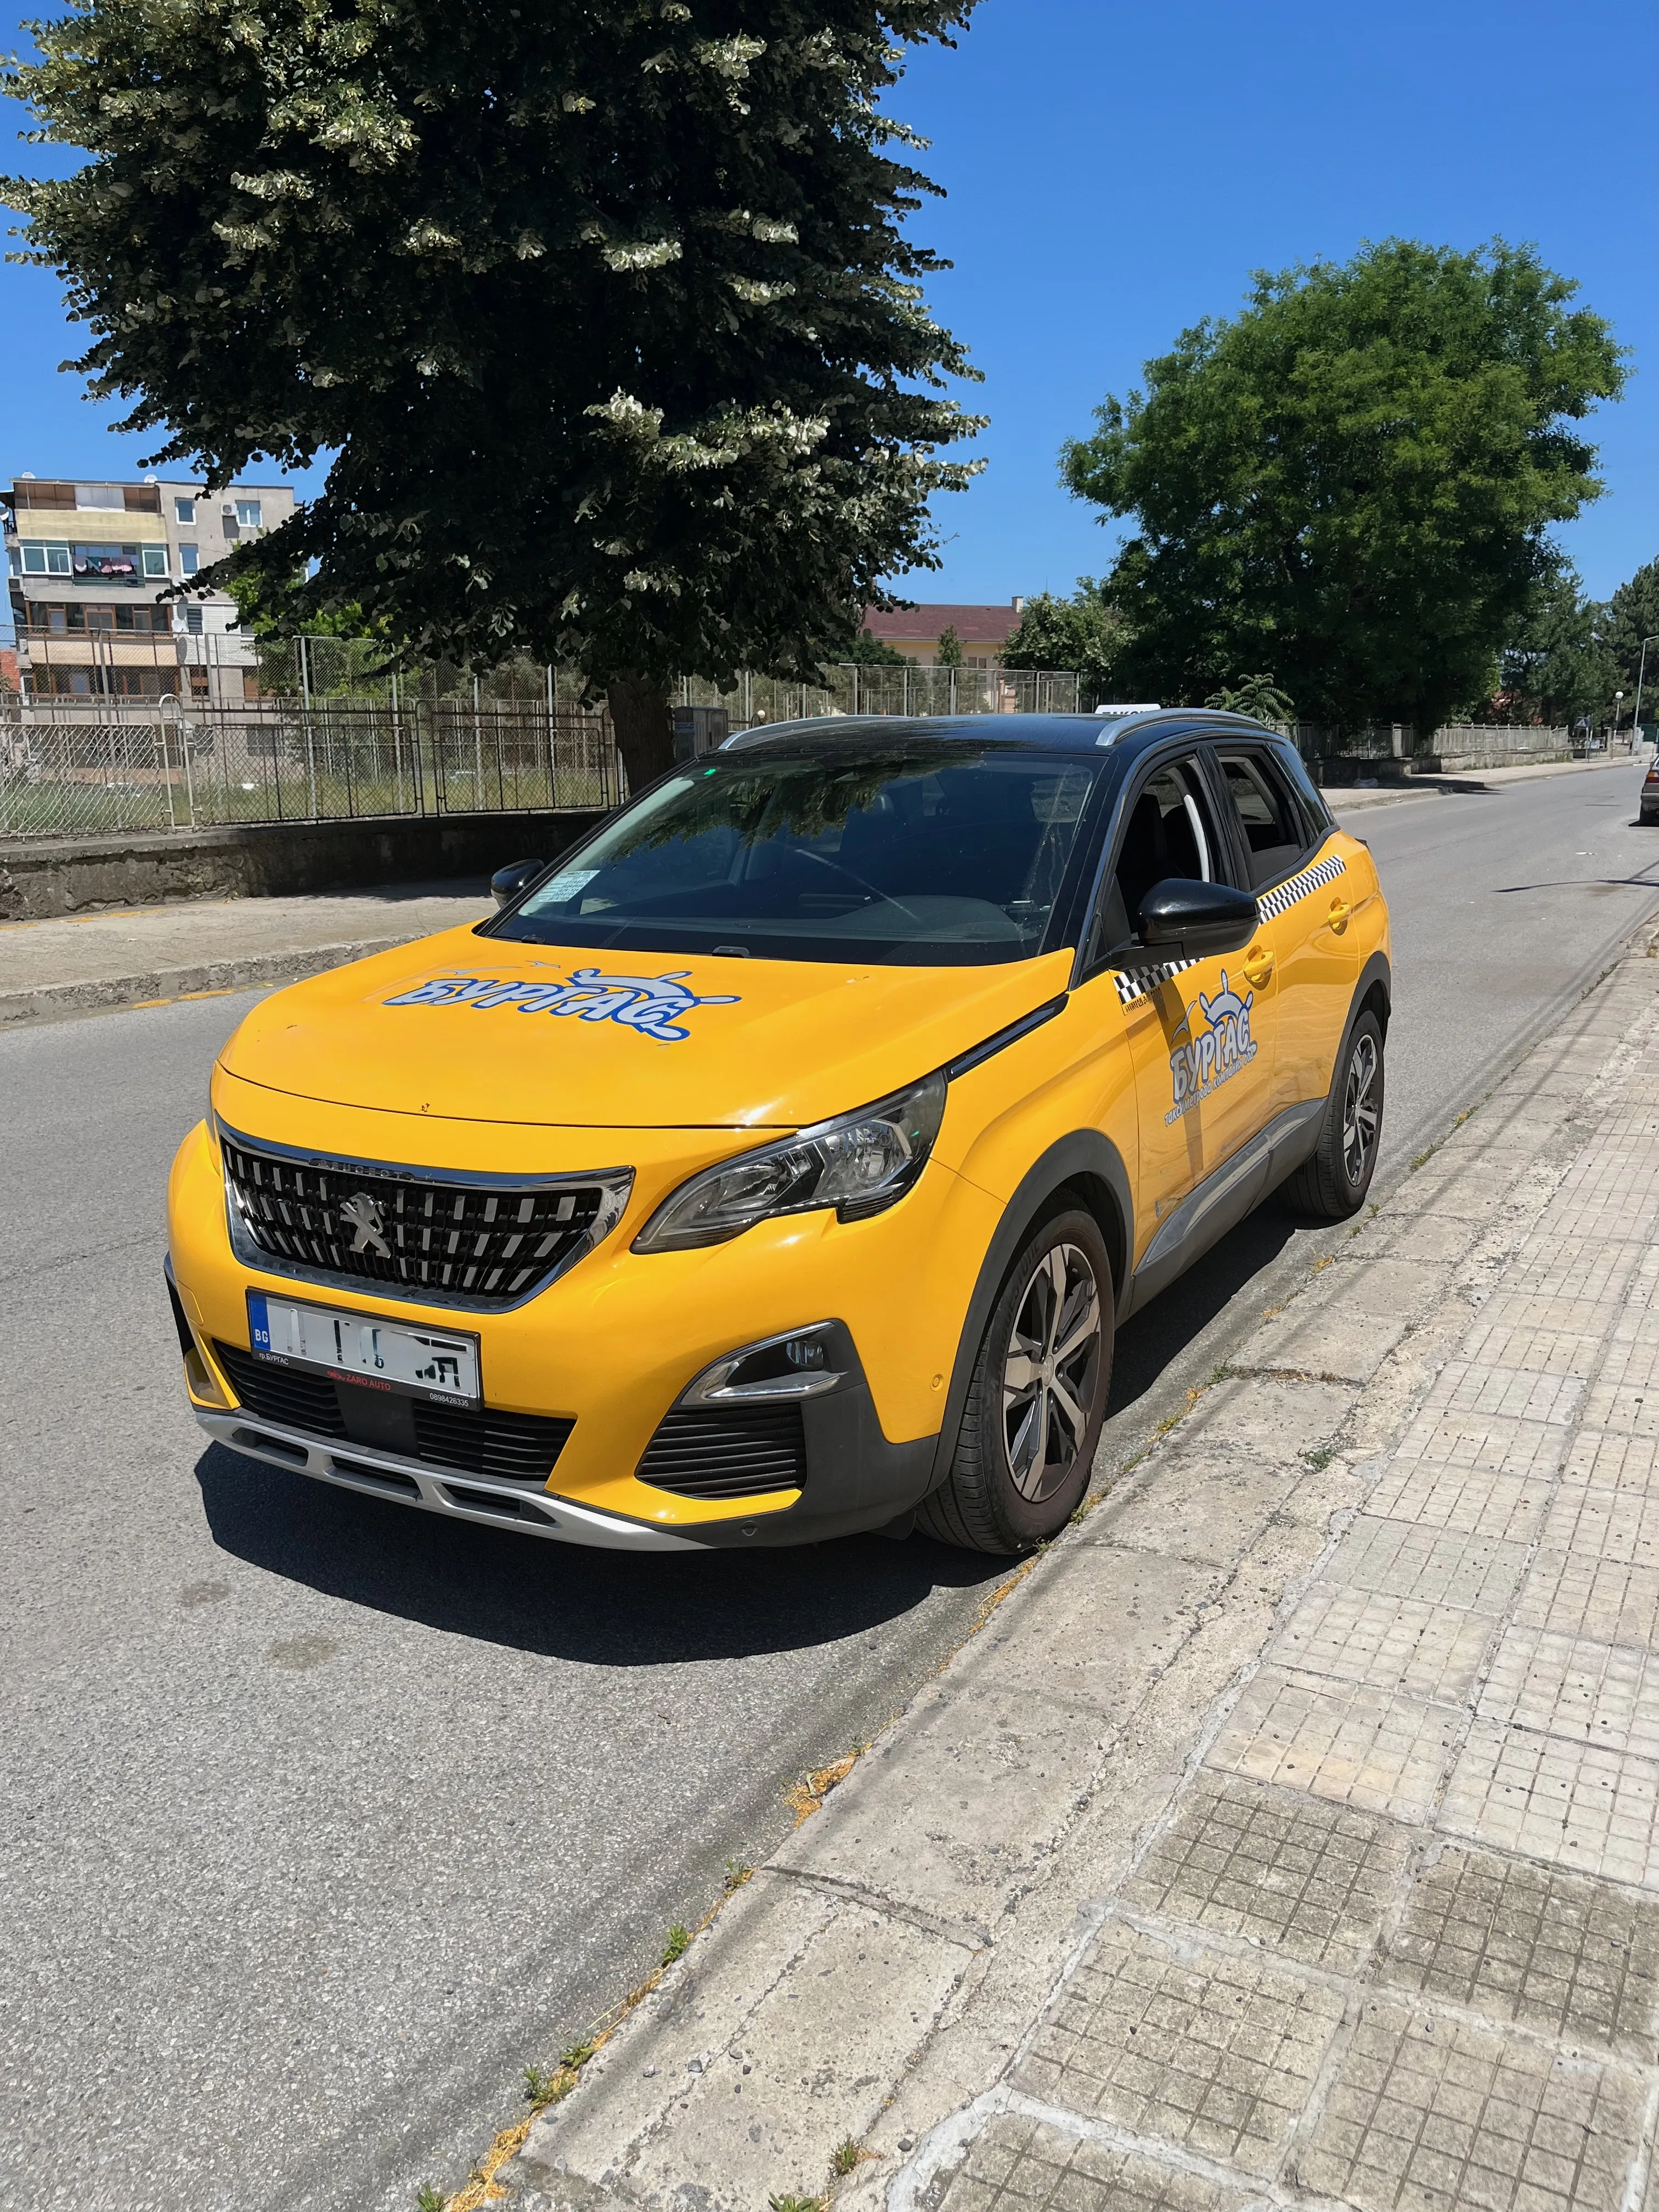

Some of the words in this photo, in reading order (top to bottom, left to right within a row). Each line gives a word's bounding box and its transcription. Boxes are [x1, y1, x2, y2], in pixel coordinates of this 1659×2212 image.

[382, 978, 698, 1041] БУРГАС
[1169, 1005, 1258, 1104] БУРГАС
[318, 1159, 403, 1180] PEUGEOT
[255, 1328, 269, 1344] BG
[346, 1374, 368, 1386] ZARO
[369, 1379, 391, 1391] AUTO
[430, 1392, 469, 1407] 0898426335
